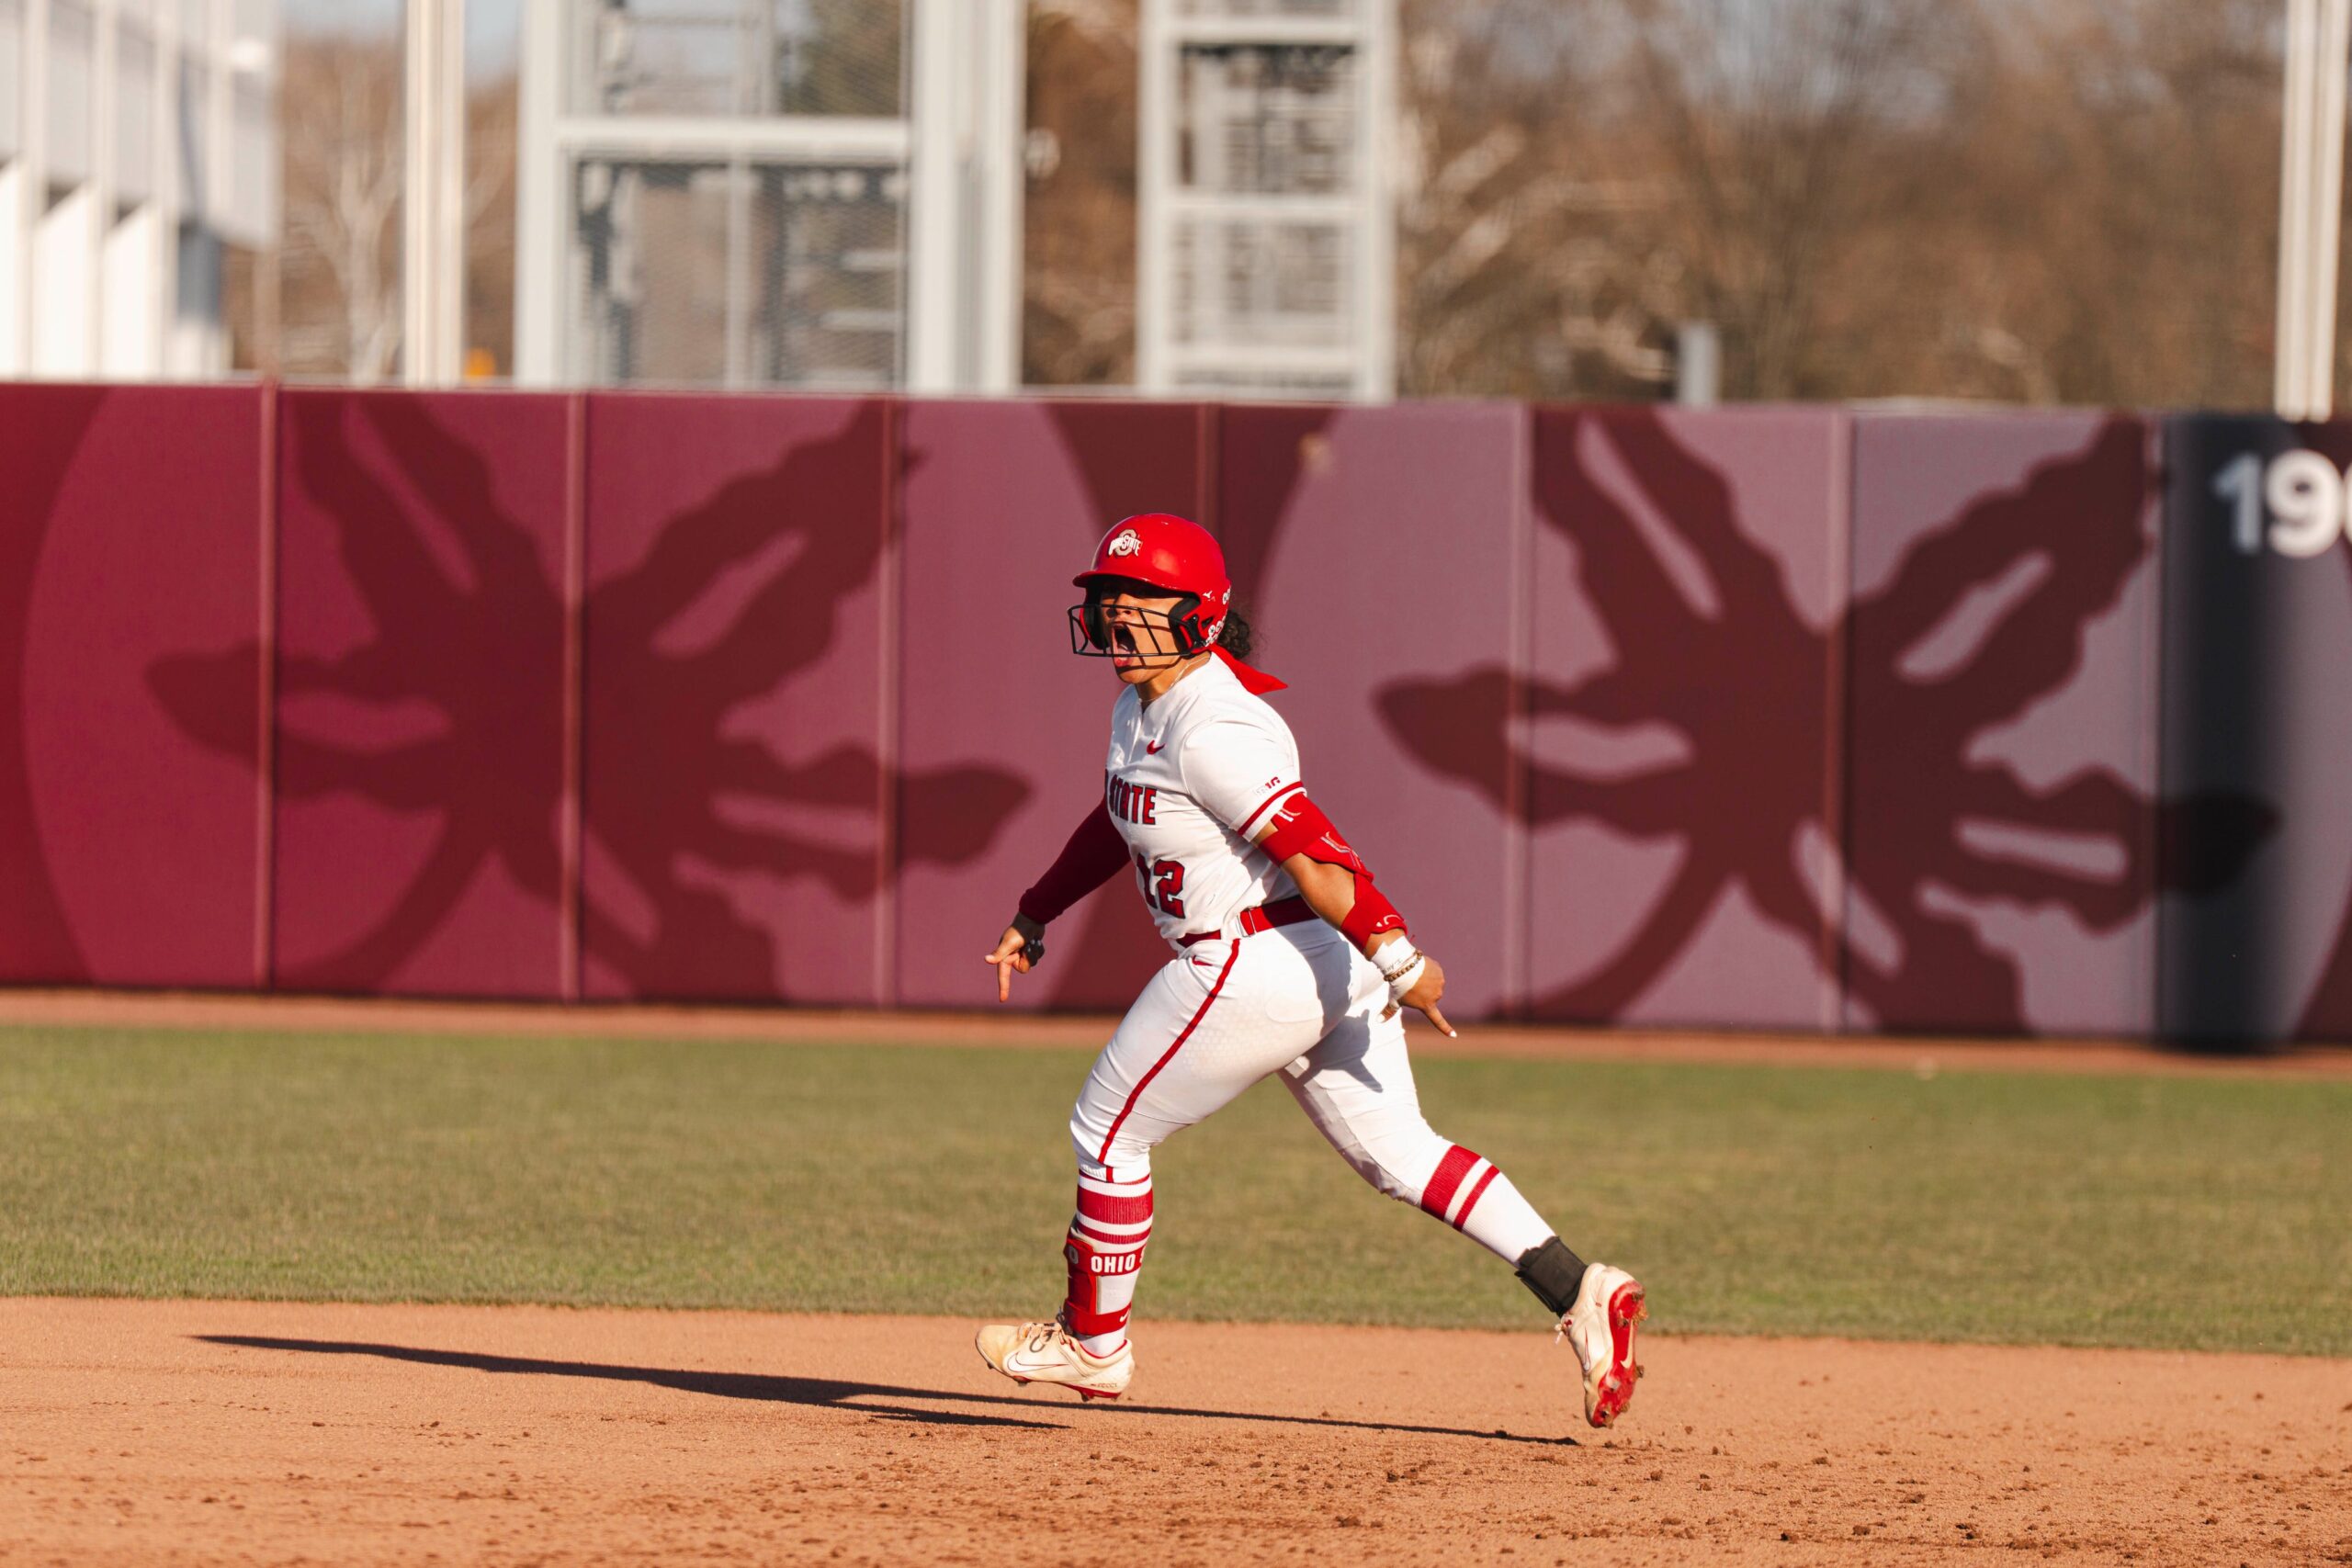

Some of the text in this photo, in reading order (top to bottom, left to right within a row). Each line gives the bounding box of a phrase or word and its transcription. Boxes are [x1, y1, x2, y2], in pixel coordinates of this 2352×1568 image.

[2213, 448, 2352, 559] 19
[1136, 852, 1186, 919] 12
[1091, 1253, 1136, 1273] OHIO
